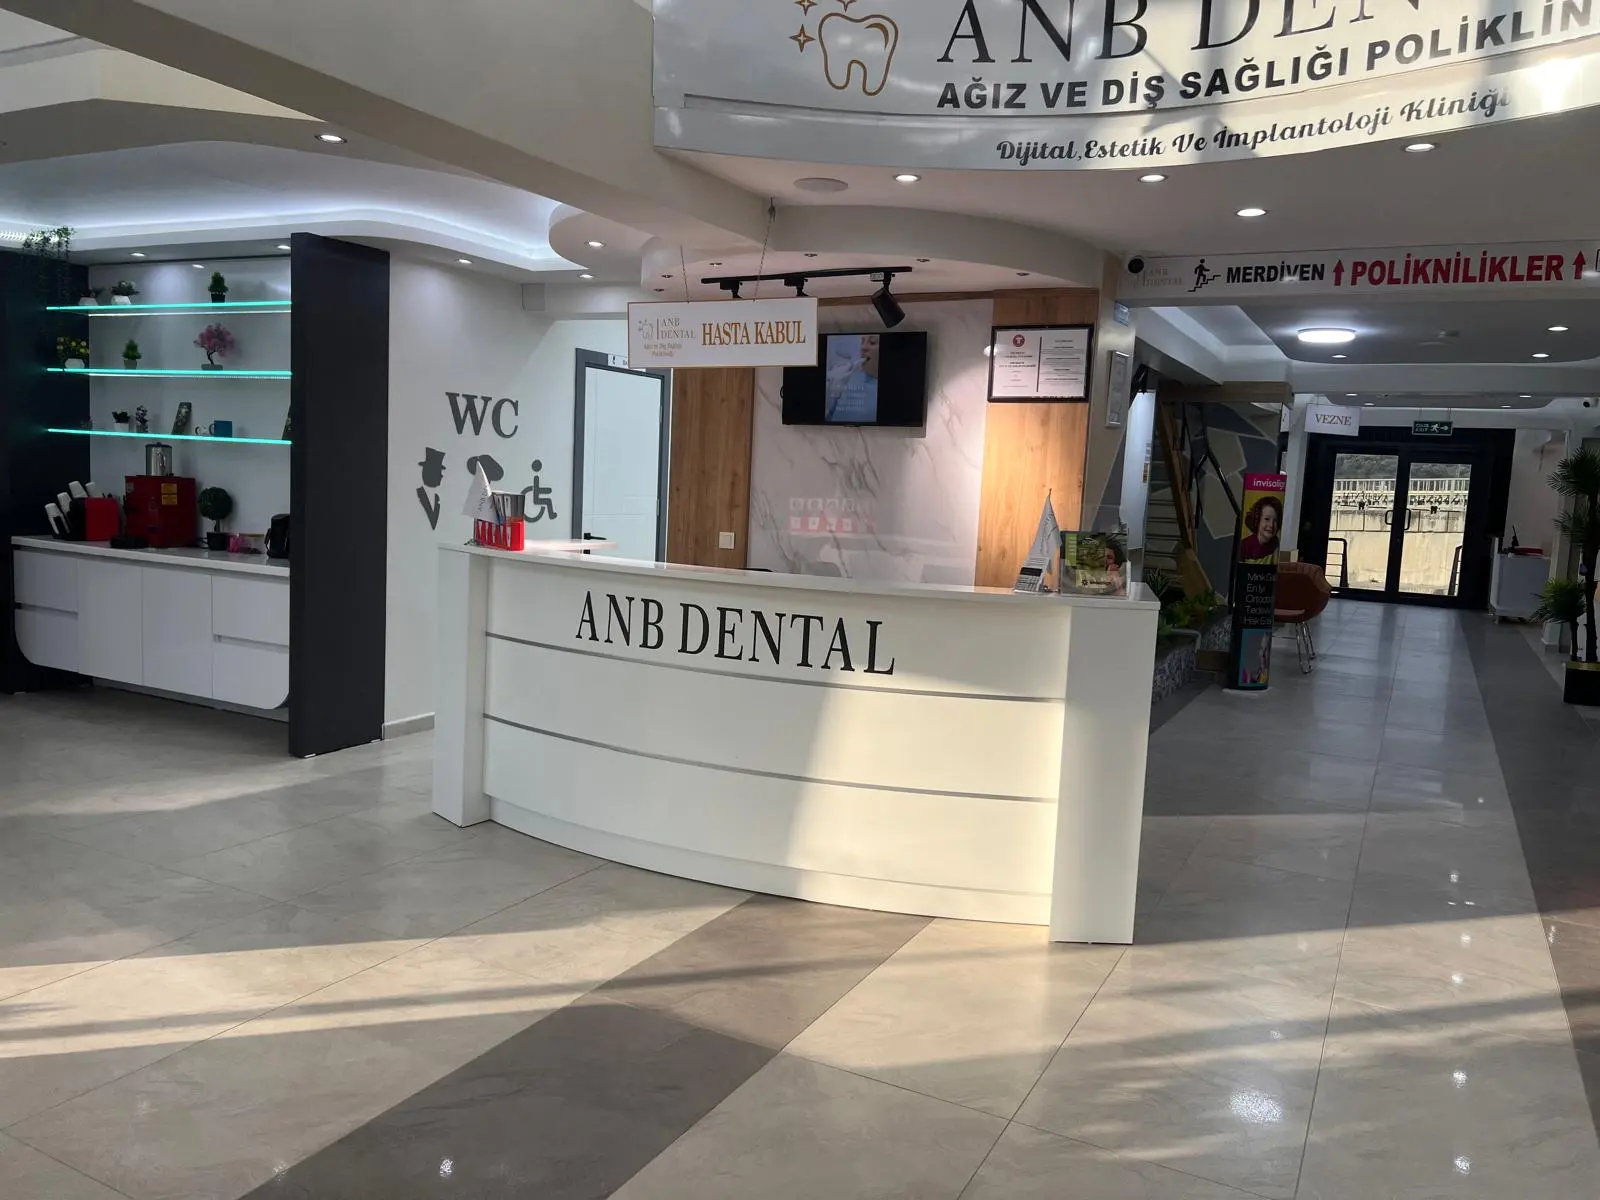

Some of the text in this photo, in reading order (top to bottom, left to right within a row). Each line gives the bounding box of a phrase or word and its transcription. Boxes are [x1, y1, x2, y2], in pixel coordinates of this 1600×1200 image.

[936, 0, 1148, 63] ANB
[936, 76, 1027, 109] AĞIZ
[1039, 80, 1088, 108] VE
[1101, 71, 1165, 110] DİŞ
[1179, 44, 1349, 100] SAĞLIĞI
[1172, 132, 1208, 153] Ve
[1213, 106, 1393, 150] İmplantoloji
[1400, 87, 1512, 118] Kliniği
[1226, 250, 1564, 286] MERDİVEN POLİKNİLİKLER
[660, 317, 680, 327] ANB
[660, 329, 696, 340] DENTAL
[702, 320, 806, 346] HASTA KABUL
[445, 391, 519, 438] WC
[1315, 413, 1352, 426] VEZNE
[575, 590, 895, 676] ANB DENTAL
